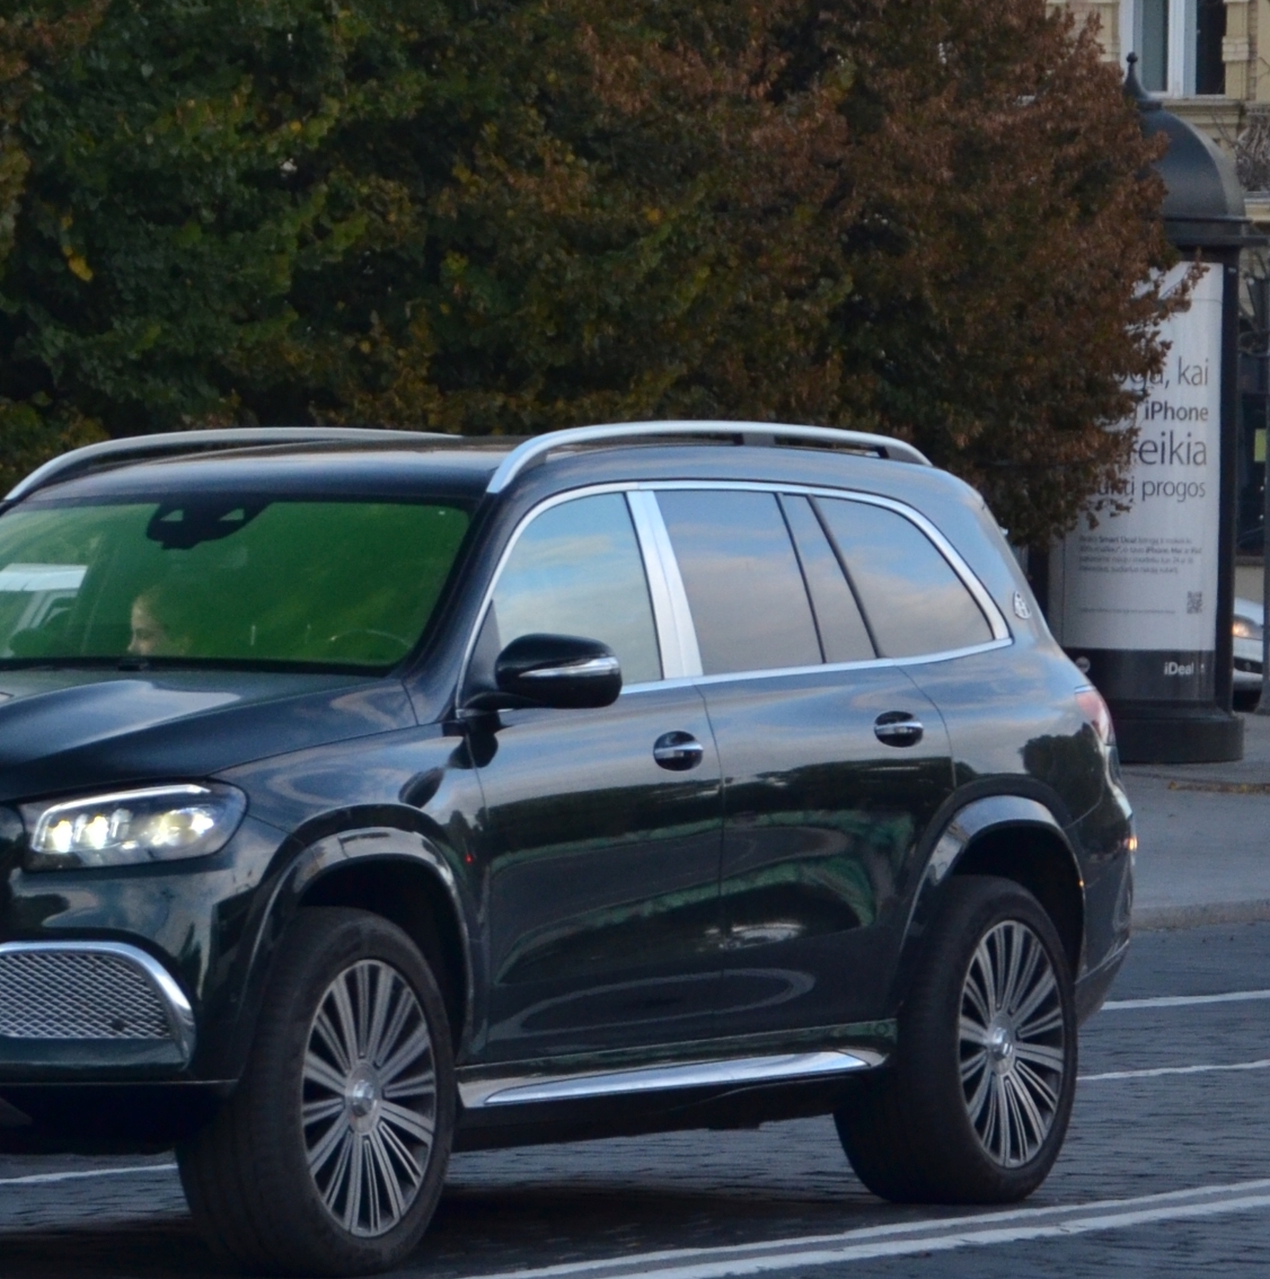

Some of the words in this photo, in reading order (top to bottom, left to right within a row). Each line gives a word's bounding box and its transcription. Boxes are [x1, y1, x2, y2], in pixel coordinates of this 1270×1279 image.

[1177, 355, 1209, 387] kai
[1144, 400, 1209, 422] iPhone
[1141, 479, 1206, 503] progos
[1164, 661, 1194, 676] iDeal
